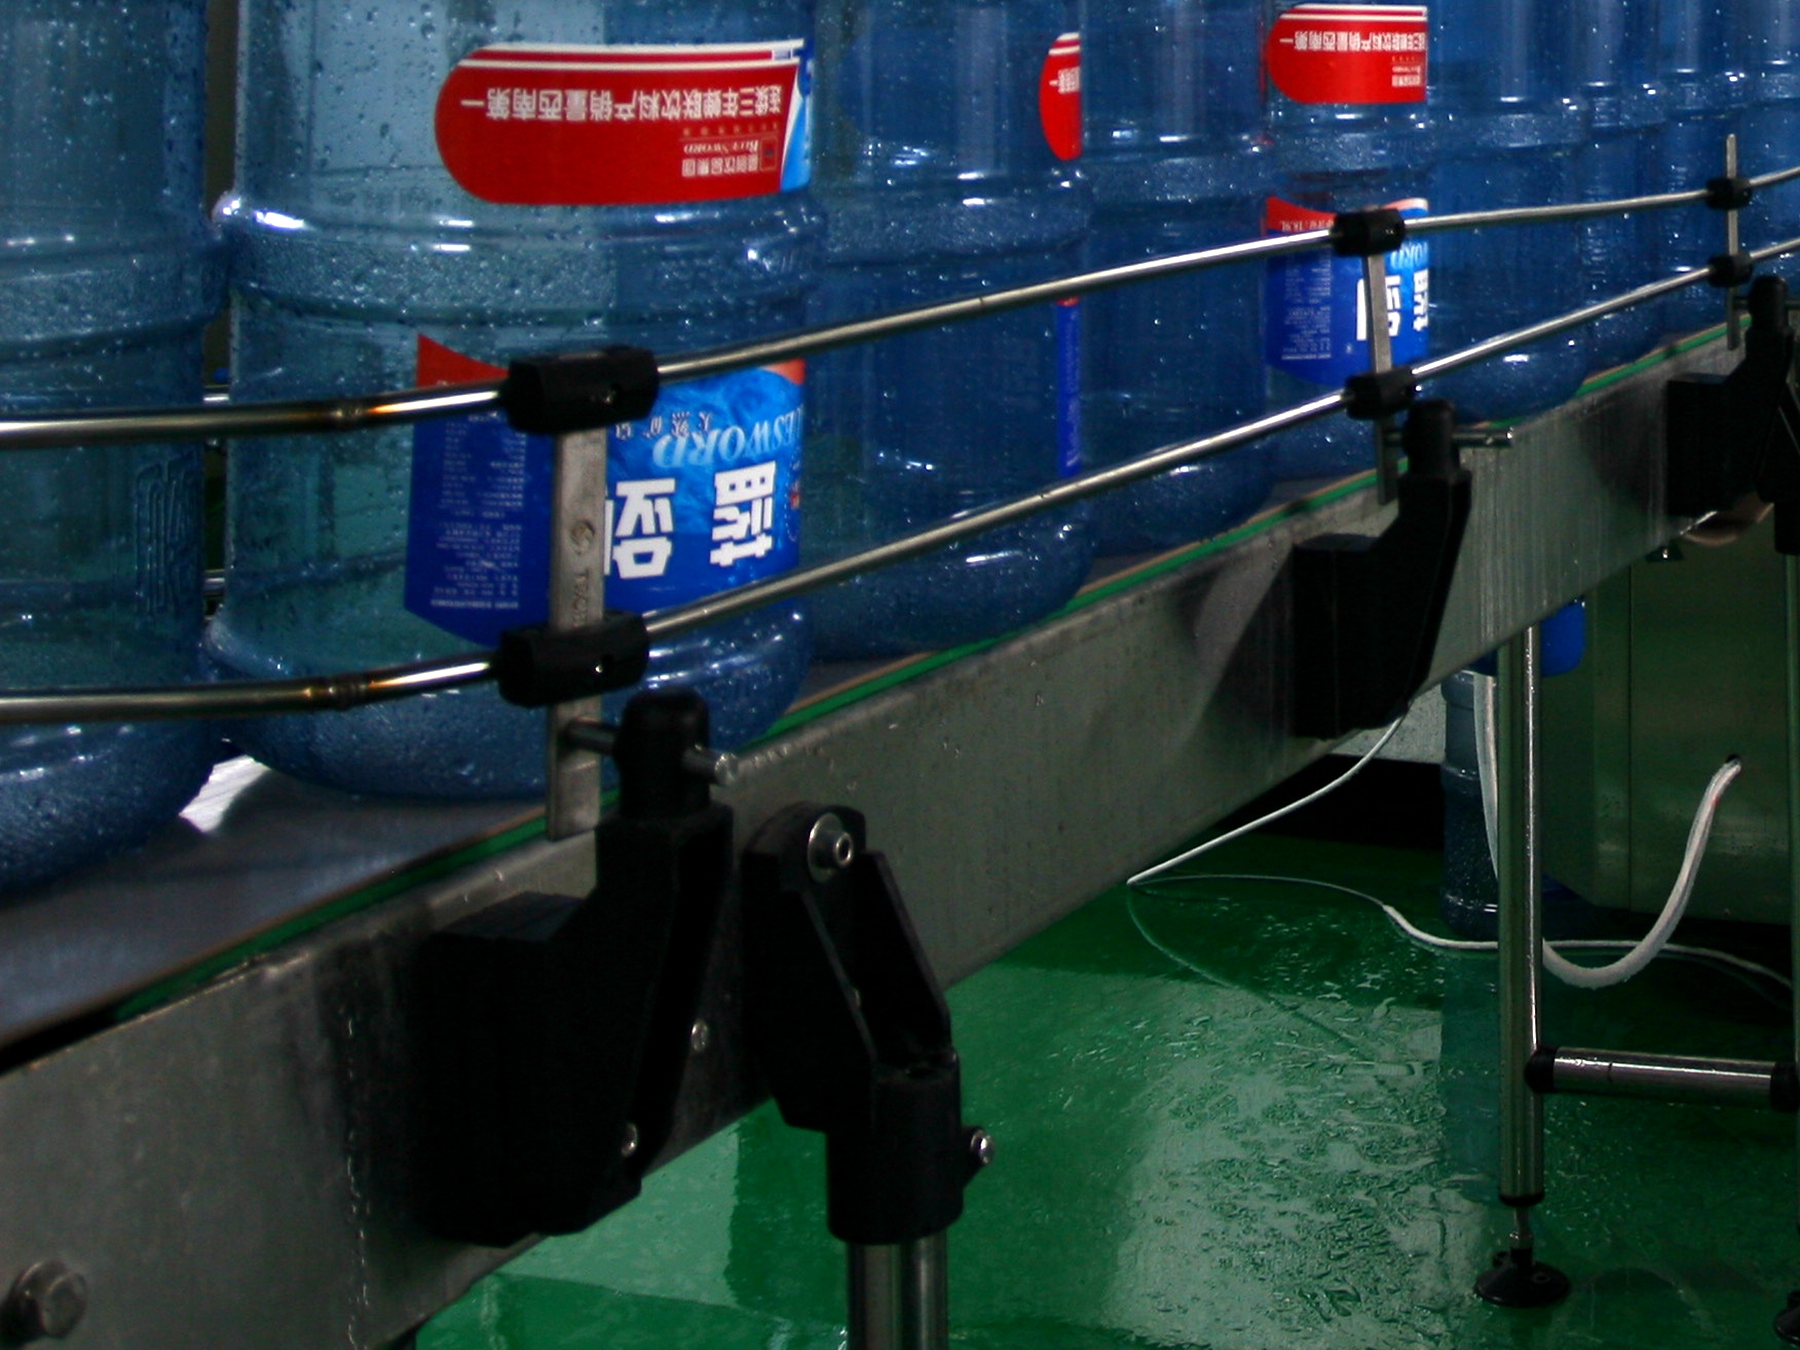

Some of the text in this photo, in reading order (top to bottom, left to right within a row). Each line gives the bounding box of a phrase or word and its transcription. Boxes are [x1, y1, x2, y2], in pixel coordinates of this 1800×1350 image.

[460, 85, 782, 122] 连续三年蝉联饮料产销量西南第一
[603, 460, 776, 580] 蓝剑
